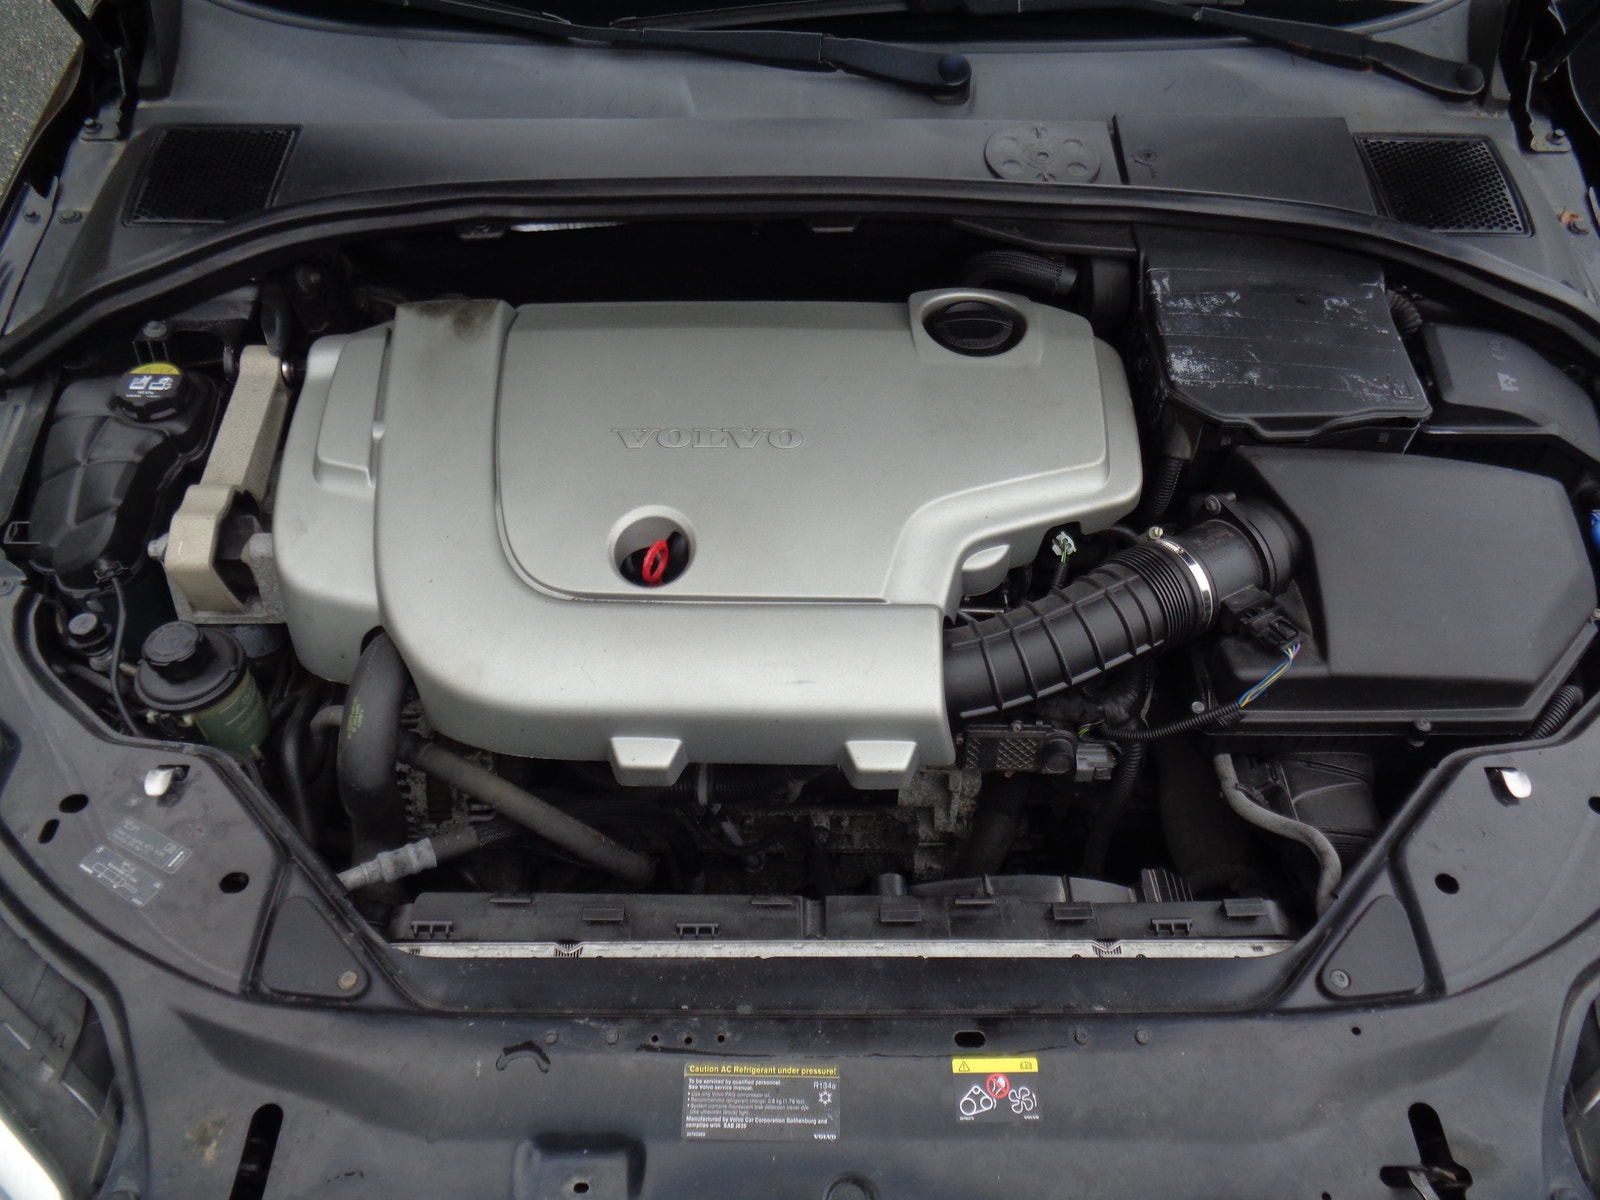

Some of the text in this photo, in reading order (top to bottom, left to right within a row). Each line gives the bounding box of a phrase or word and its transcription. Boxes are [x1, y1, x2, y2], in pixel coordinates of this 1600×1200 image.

[611, 428, 804, 449] VOLVO
[689, 1065, 719, 1073] Caution
[733, 1066, 776, 1075] Refrigerant
[777, 1066, 800, 1074] under
[801, 1067, 837, 1075] pressure!
[813, 1081, 837, 1090] R134a
